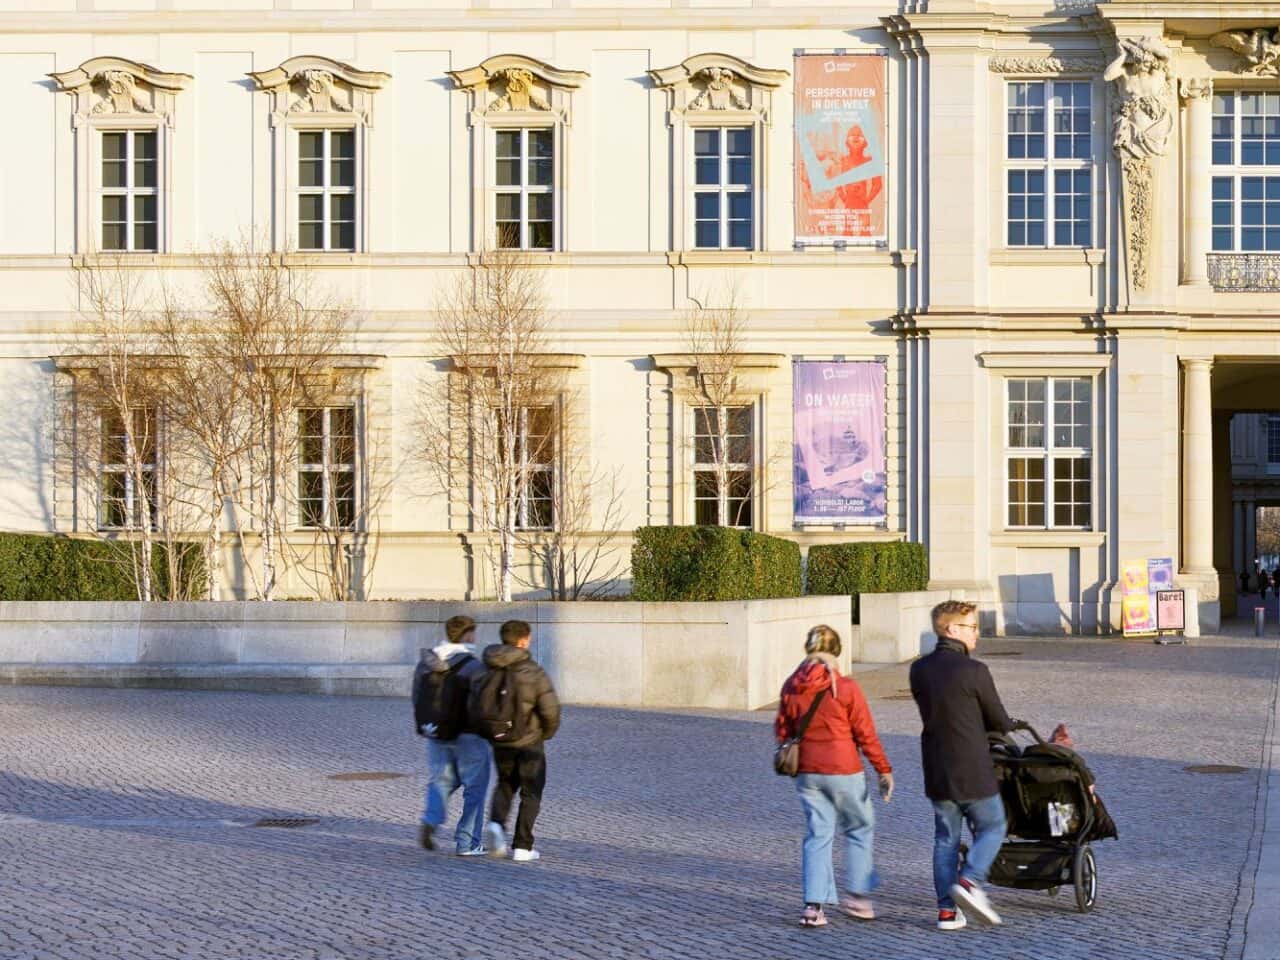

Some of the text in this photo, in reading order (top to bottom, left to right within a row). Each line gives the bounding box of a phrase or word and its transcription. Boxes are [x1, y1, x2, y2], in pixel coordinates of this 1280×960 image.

[805, 87, 876, 98] PERSPEKTIVEN
[811, 99, 870, 110] IN DIE WELT
[805, 393, 824, 407] ON
